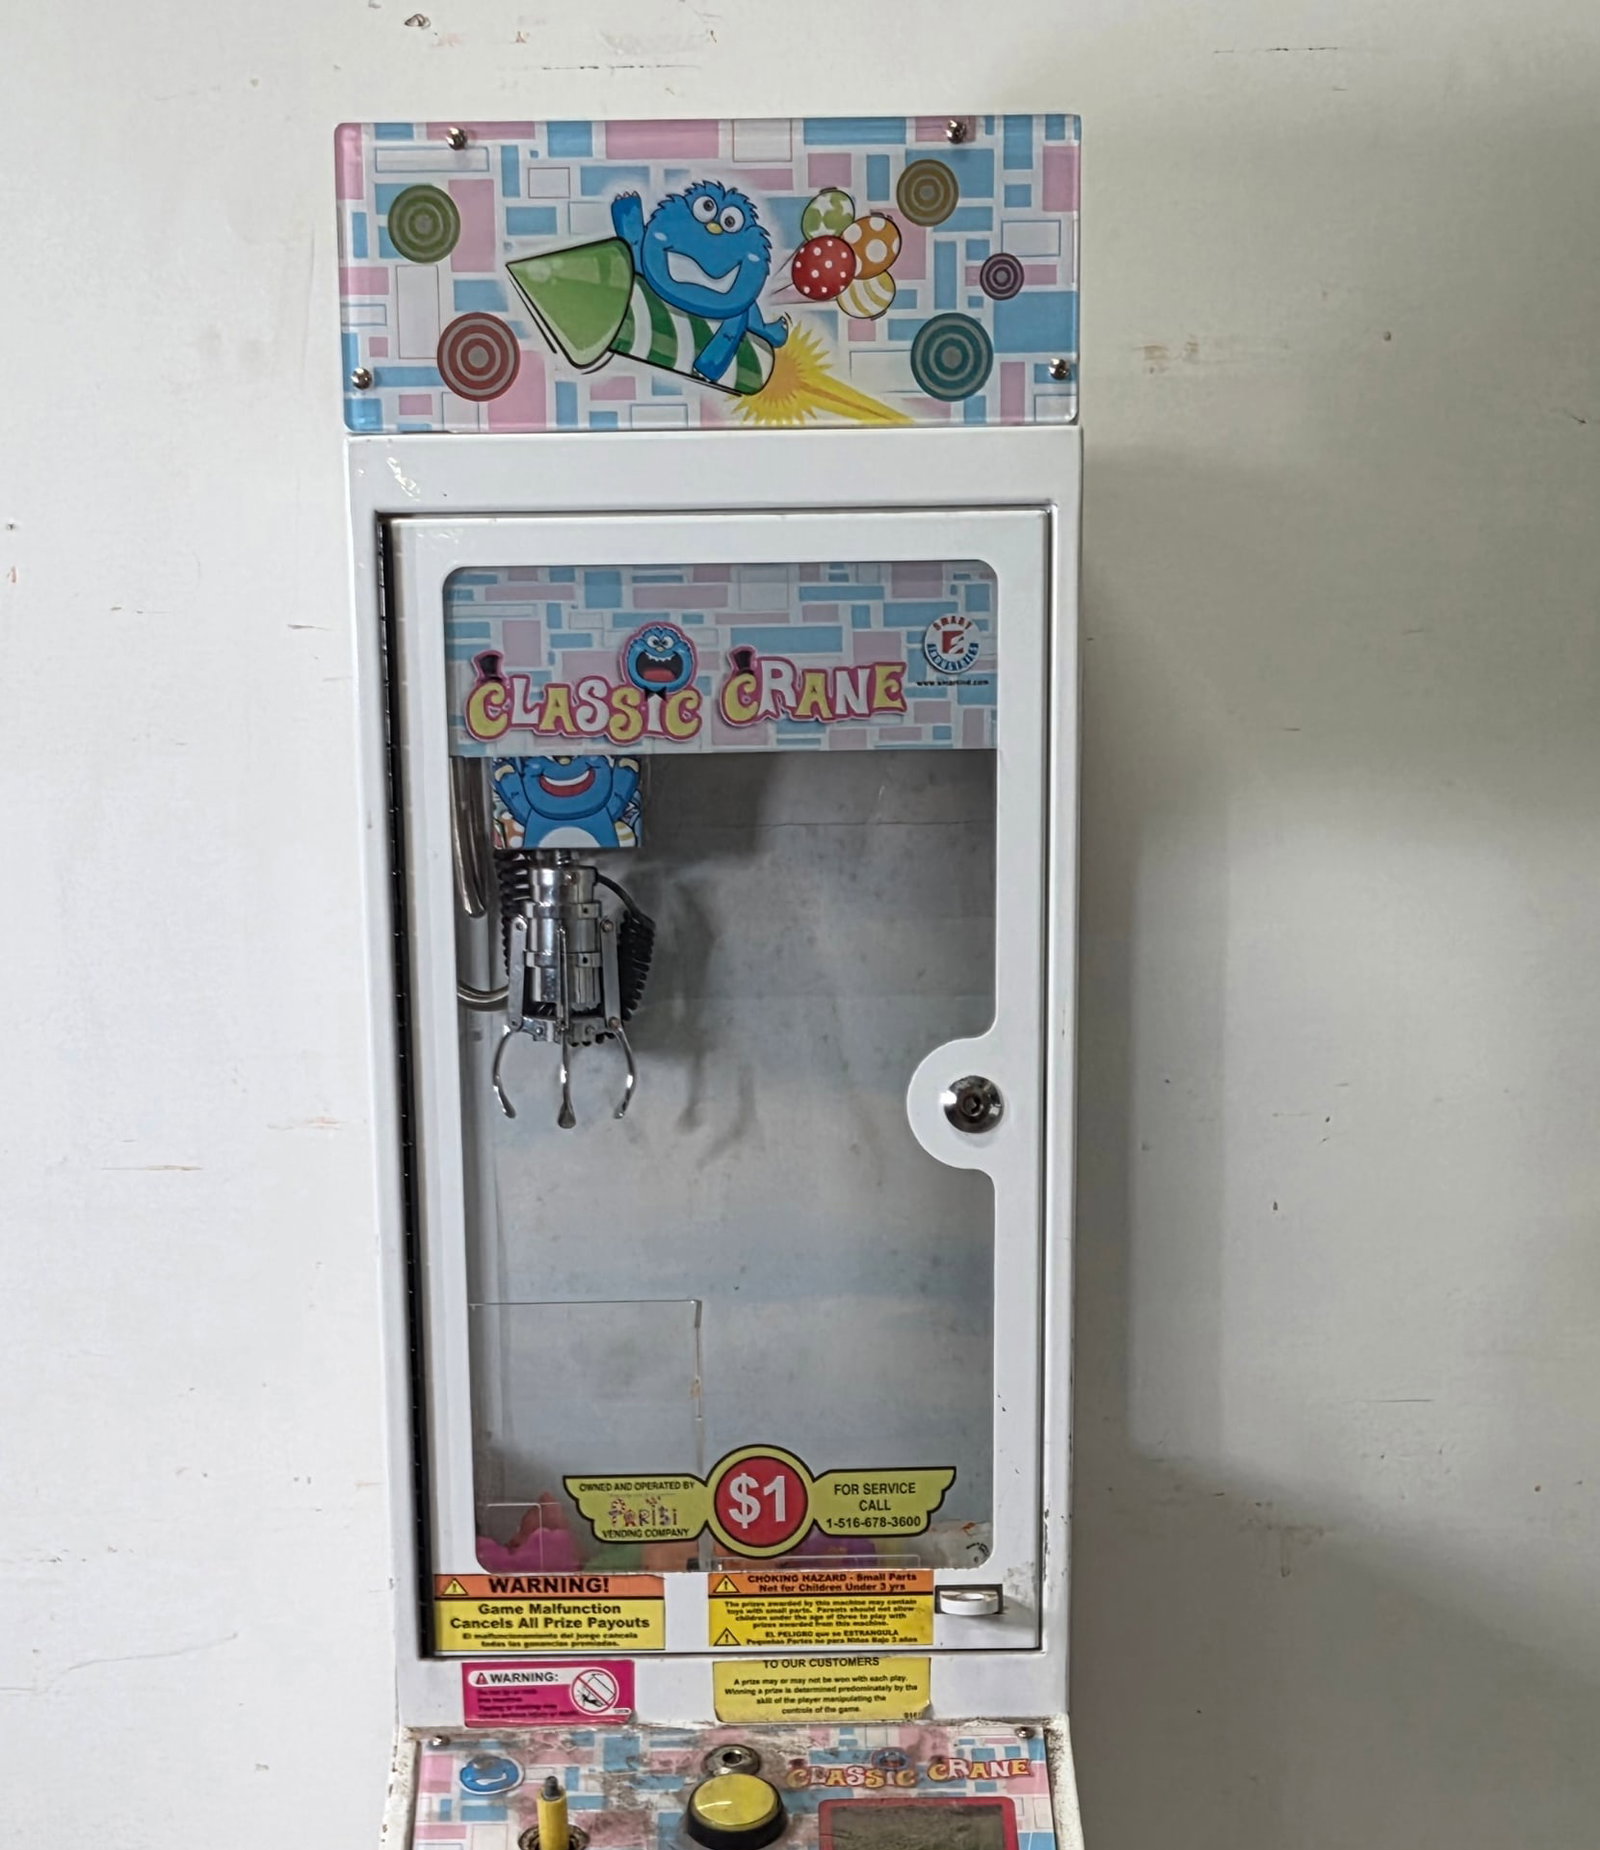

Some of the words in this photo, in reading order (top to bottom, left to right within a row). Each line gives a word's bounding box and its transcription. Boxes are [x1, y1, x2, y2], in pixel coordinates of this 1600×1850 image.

[467, 674, 702, 744] CLASSIC
[721, 658, 906, 725] CRANE
[579, 1483, 612, 1492] OWNED
[614, 1482, 632, 1491] AND
[634, 1482, 681, 1490] OPERATED
[683, 1481, 695, 1489] BY
[834, 1484, 860, 1496] FOR
[863, 1482, 916, 1495] SERVICE
[728, 1472, 786, 1529] $1
[859, 1500, 892, 1512] CALL
[826, 1516, 921, 1528] 1-516-678-3600
[602, 1529, 642, 1538] VENDING
[644, 1528, 690, 1537] COMPANY
[748, 1574, 799, 1583] CHOKING
[802, 1573, 846, 1582] HAZARD
[856, 1573, 886, 1582] Small
[889, 1572, 917, 1581] Parts
[488, 1577, 609, 1593] WARNING!
[759, 1584, 778, 1592] Not
[781, 1584, 795, 1592] for
[798, 1583, 842, 1592] Children
[845, 1583, 877, 1591] Under
[880, 1582, 886, 1591] 3
[889, 1584, 906, 1592] yrs
[478, 1603, 524, 1614] Game
[529, 1603, 622, 1614] Malfunction
[450, 1617, 514, 1629] Cancels
[518, 1617, 538, 1628] All
[544, 1617, 582, 1628] Prize
[588, 1616, 650, 1631] Payouts
[763, 1659, 778, 1669] TO
[781, 1659, 806, 1668] OUR
[809, 1657, 880, 1667] CUSTOMERS
[490, 1672, 559, 1684] WARNING:
[725, 1688, 756, 1696] Winning
[838, 1684, 892, 1693] predominately
[894, 1684, 904, 1692] by
[823, 1695, 872, 1703] manipulating
[786, 1764, 917, 1788] CLASSIC
[927, 1757, 1032, 1782] CRANE
